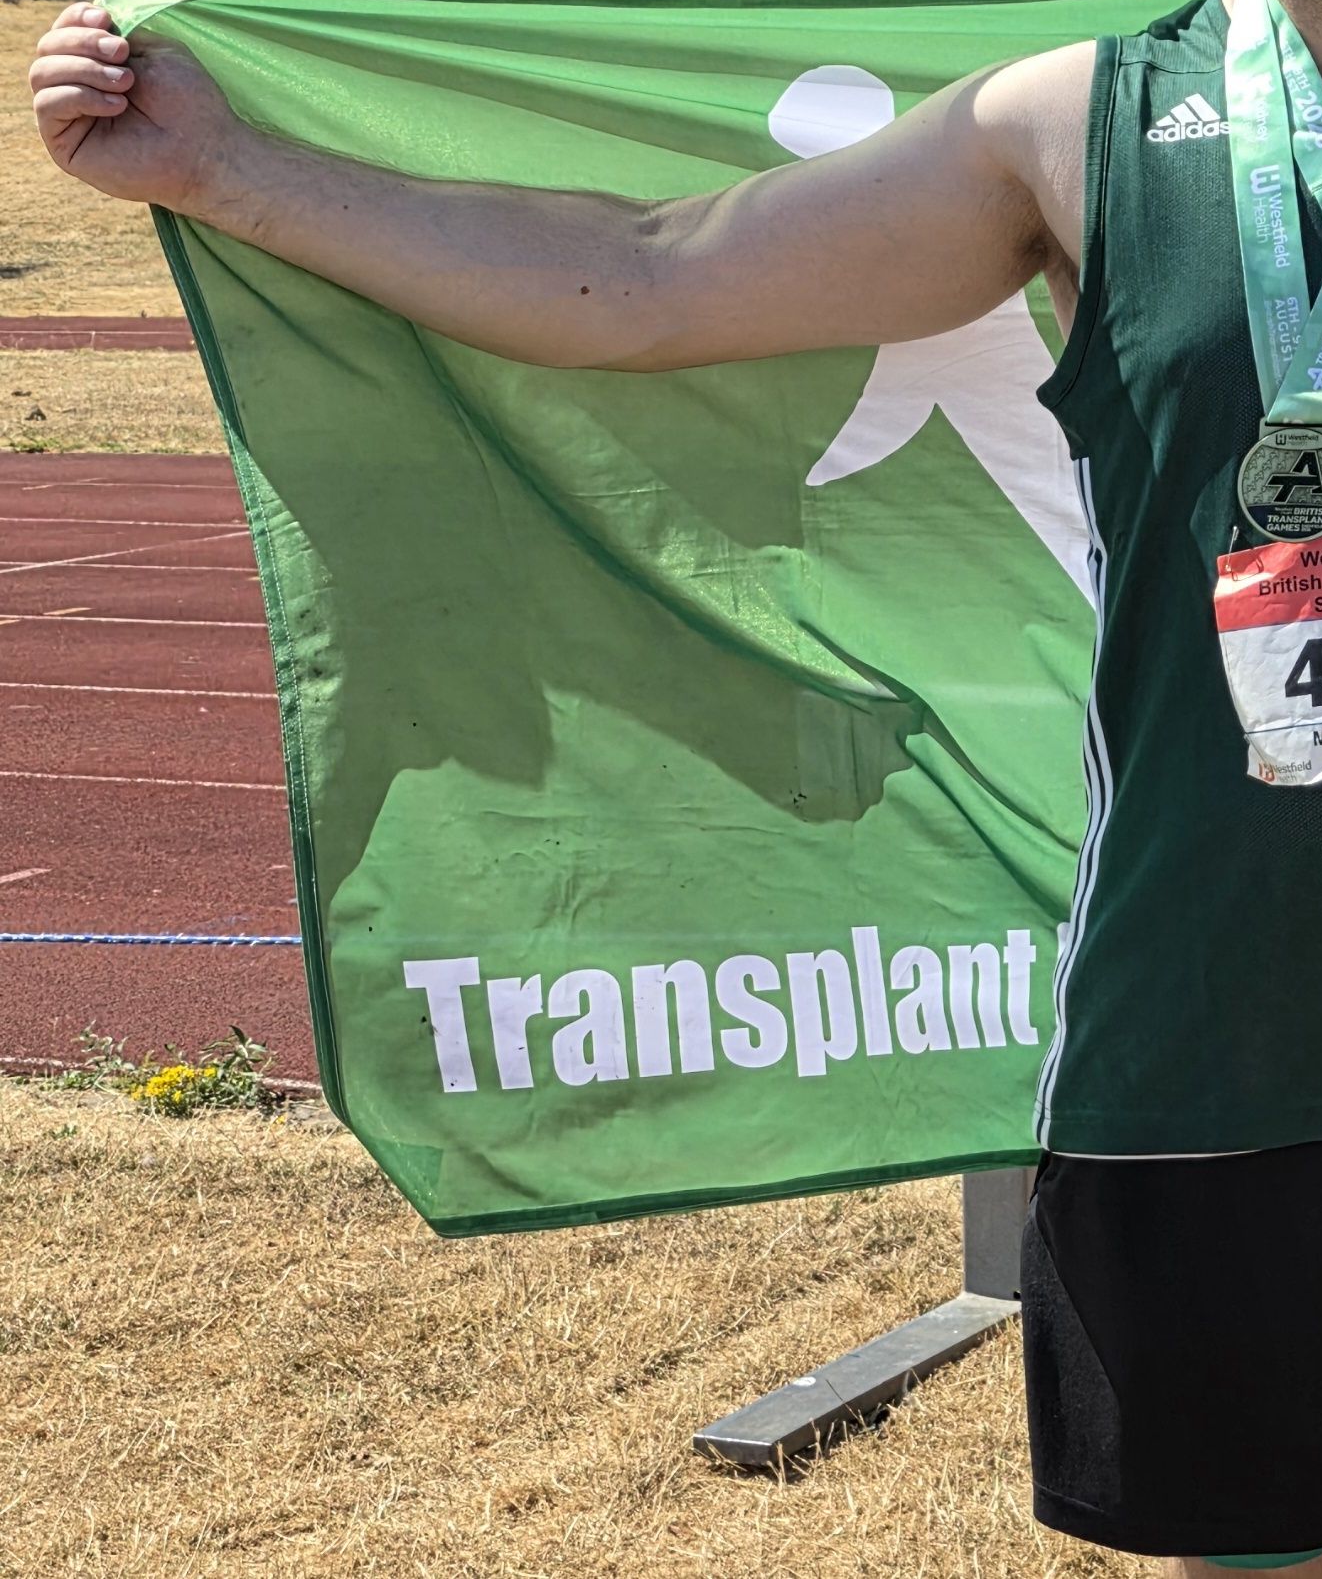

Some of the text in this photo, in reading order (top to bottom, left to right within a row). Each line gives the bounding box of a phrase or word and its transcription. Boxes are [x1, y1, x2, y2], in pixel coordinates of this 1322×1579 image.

[1146, 120, 1231, 142] adidas
[1254, 197, 1269, 244] Health
[1269, 193, 1291, 268] Westfield
[1288, 296, 1301, 322] 6TH
[1274, 299, 1293, 362] AUGUST
[1267, 523, 1300, 531] GAMES
[1259, 574, 1322, 596] British
[403, 924, 1039, 1094] Transplant
